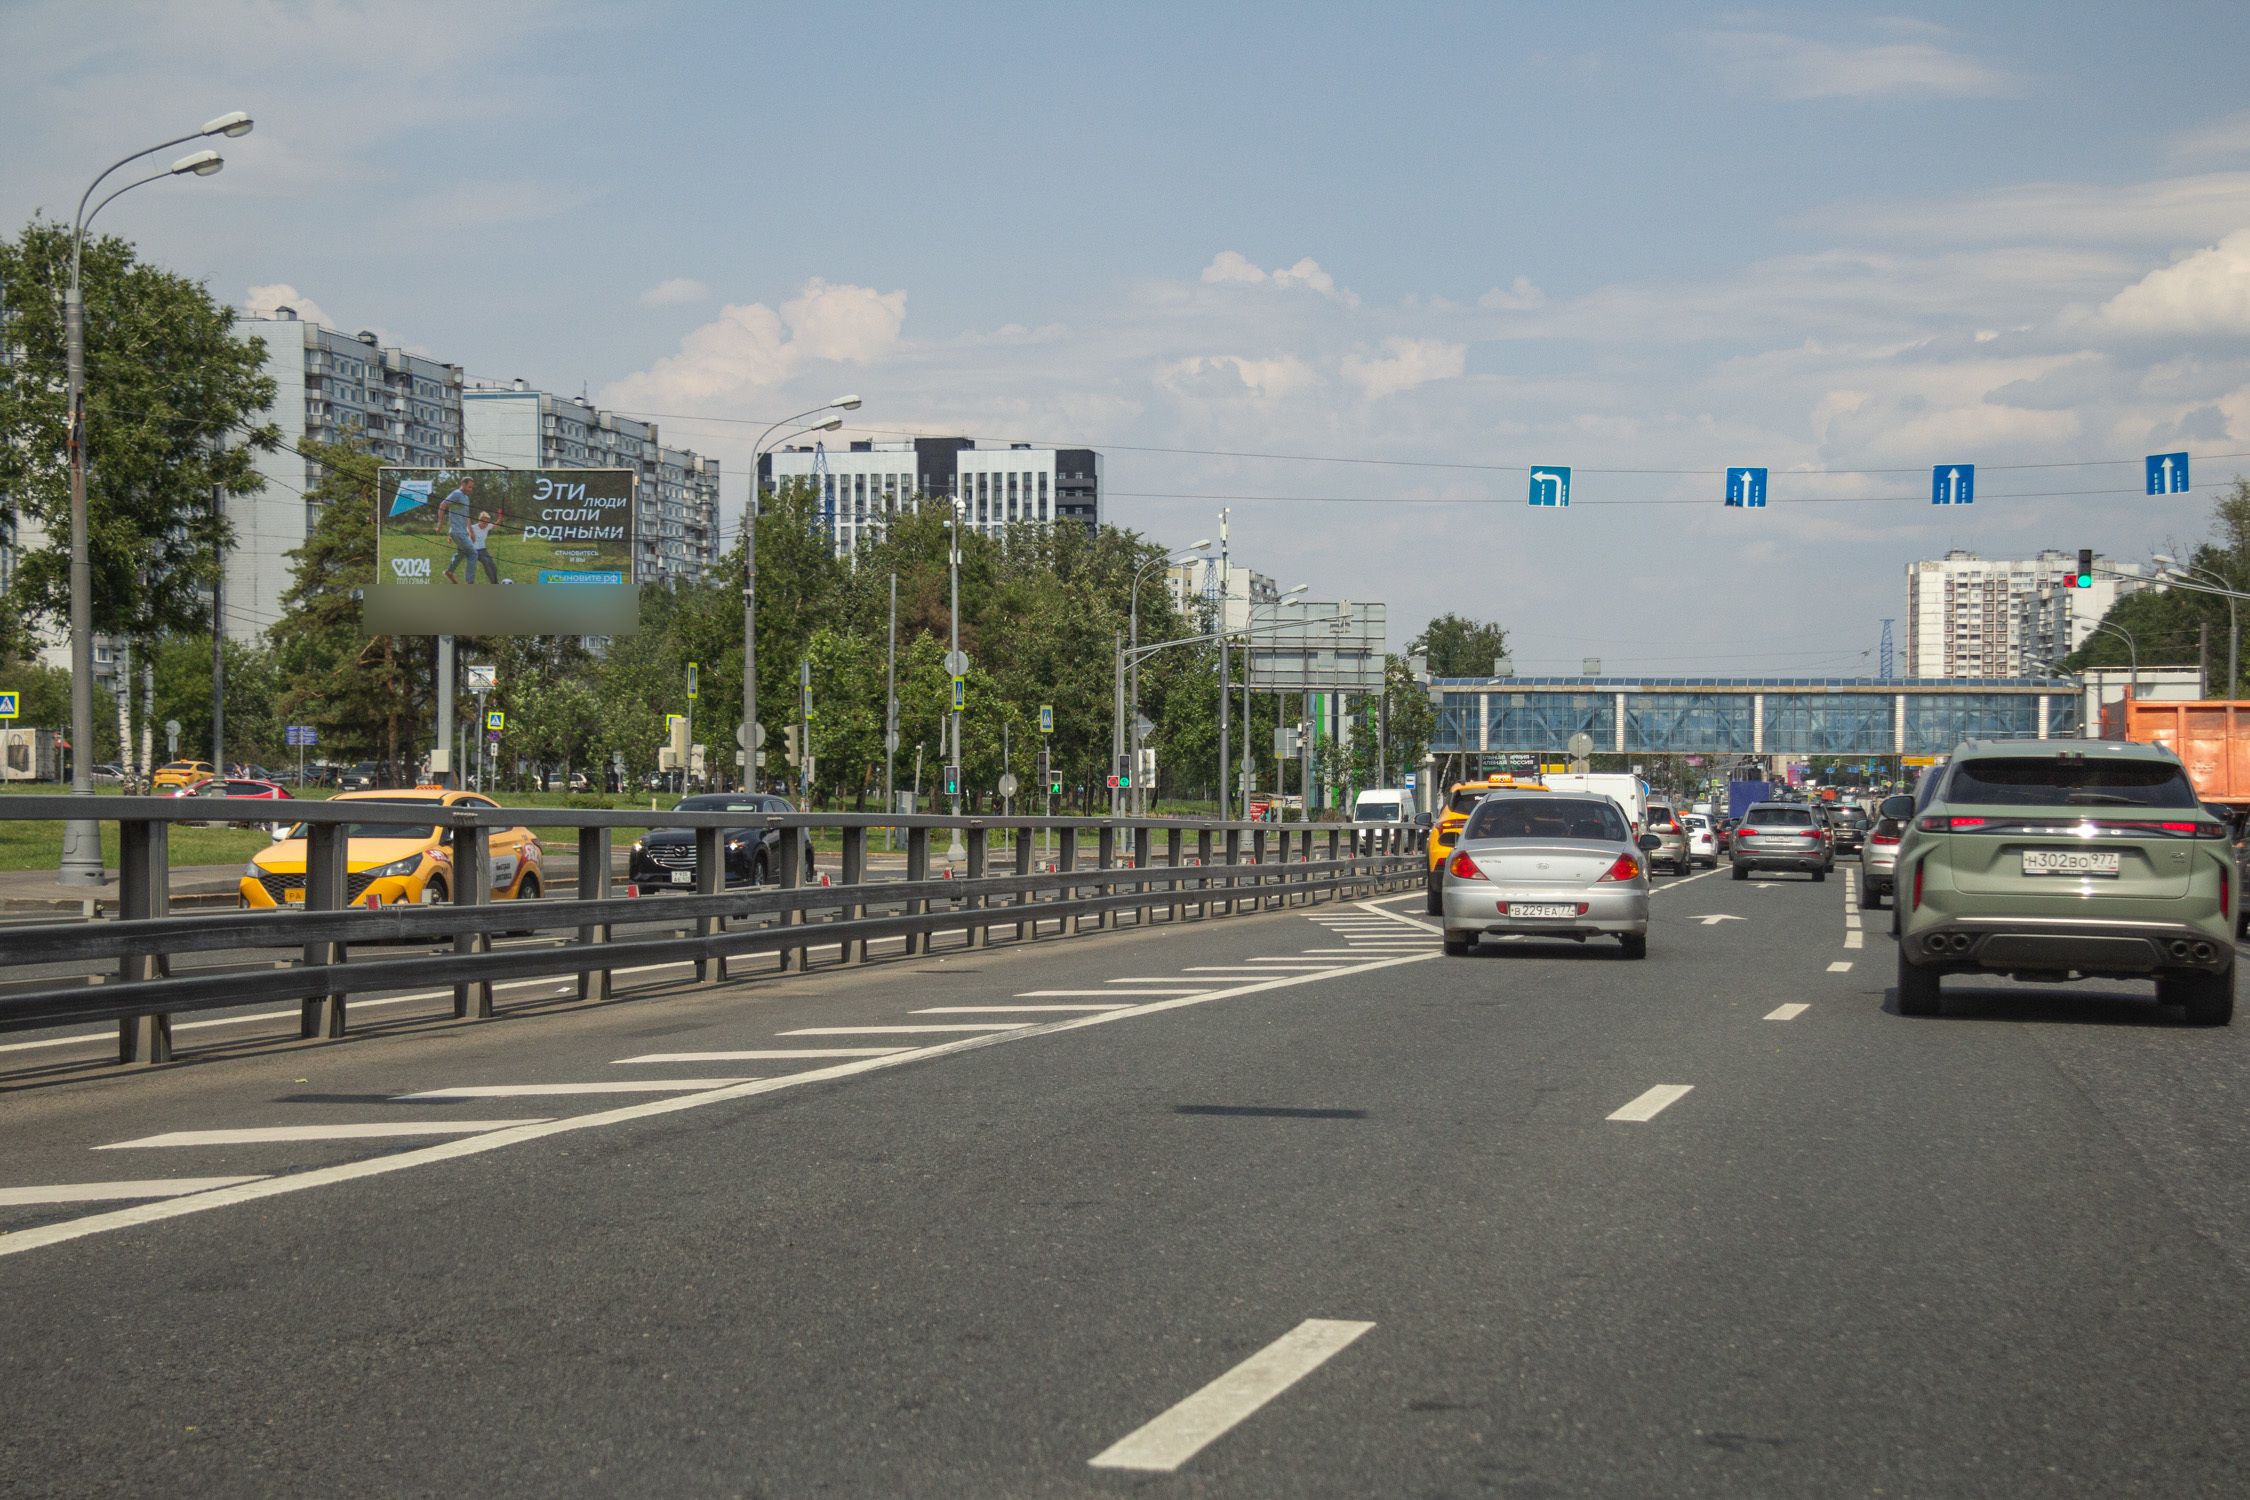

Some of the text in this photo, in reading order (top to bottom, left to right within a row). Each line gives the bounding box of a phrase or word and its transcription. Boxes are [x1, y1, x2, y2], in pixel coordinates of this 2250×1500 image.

[532, 478, 627, 509] Эти люди
[541, 508, 601, 521] стали
[522, 525, 624, 542] родными
[554, 549, 600, 557] СТАНОВИТЕСЬ
[393, 558, 432, 577] 2024
[546, 574, 619, 584] усыновите.рф
[2027, 852, 2115, 868] Н302ВО 977
[1514, 904, 1571, 916] В229ЕА 77
